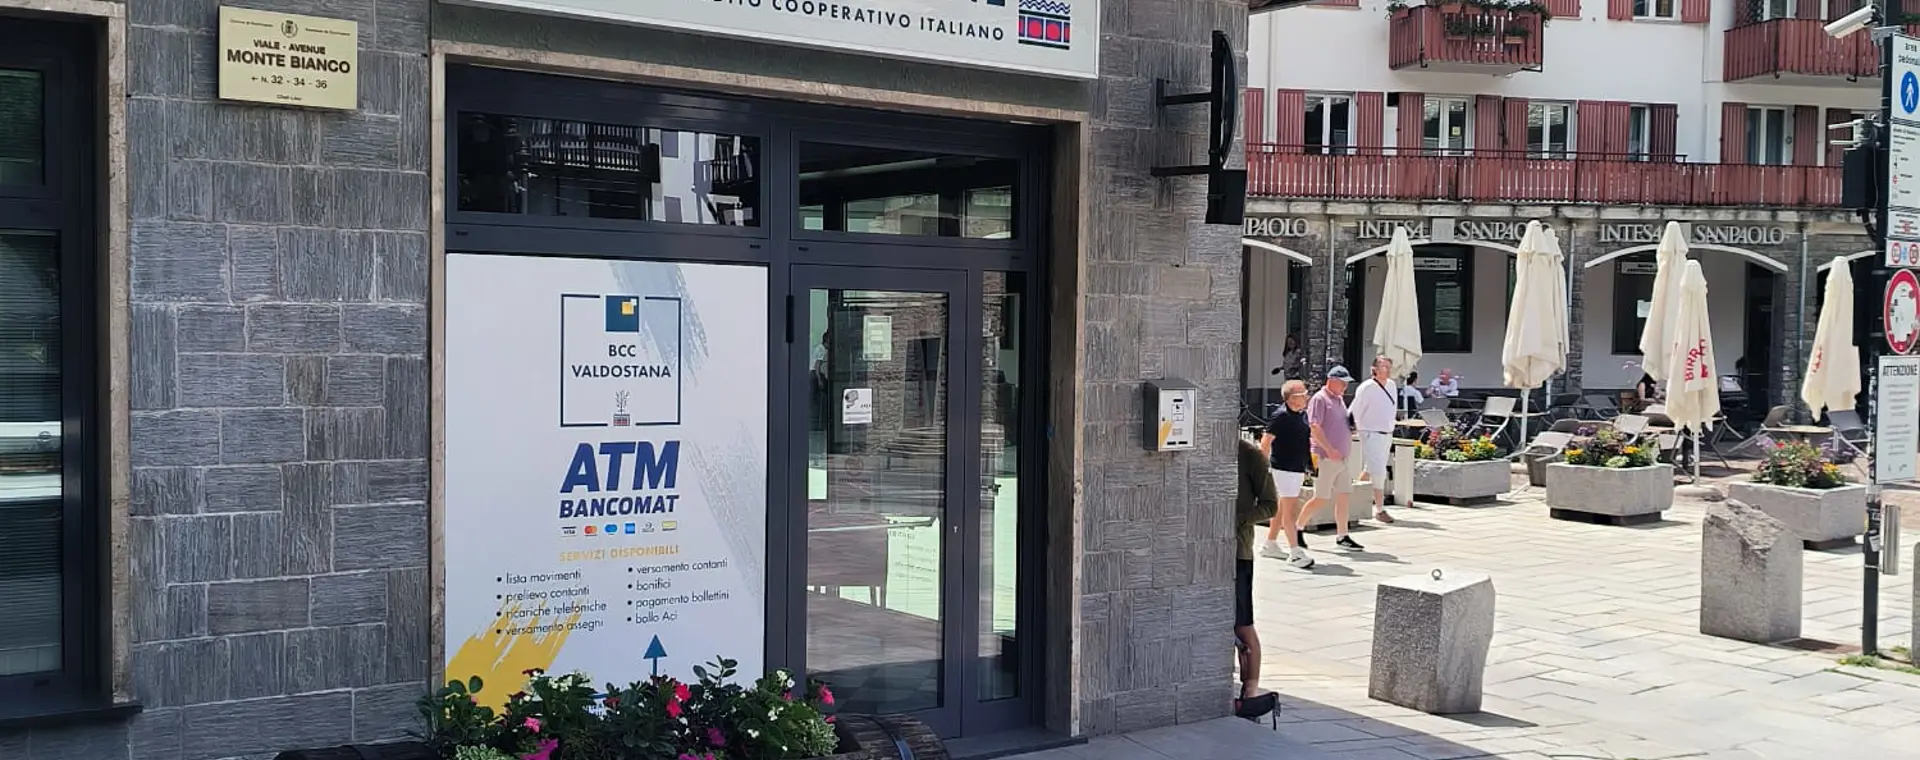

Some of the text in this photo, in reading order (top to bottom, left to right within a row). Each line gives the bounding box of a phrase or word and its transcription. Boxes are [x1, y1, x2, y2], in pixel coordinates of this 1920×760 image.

[772, 0, 1004, 41] COOPERATIVO ITALIANO
[253, 39, 280, 50] VIALE
[289, 43, 326, 55] AVENUE
[227, 49, 351, 74] MONTE BIANCO
[271, 75, 284, 85] 32
[293, 77, 305, 87] 34
[315, 79, 328, 89] 36
[1599, 223, 1785, 245] INTESA SANPAOLO
[608, 344, 636, 357] BCC
[571, 365, 672, 378] VALDOSTANA
[1883, 364, 1918, 377] ATTENZIONE
[559, 440, 681, 494] ATM
[559, 495, 680, 518] BANCOMAT
[559, 544, 679, 562] SERVIZI DISPONIBILI
[636, 557, 728, 574] versamento contanti
[506, 569, 581, 584] lista movimenti
[636, 577, 671, 591] bonifici
[506, 585, 590, 604] prelievo contanti
[635, 589, 730, 610] pagamento bollettini
[506, 600, 607, 619] ricariche telefoniche
[635, 610, 678, 624] bollo Aci
[506, 618, 604, 636] versamento assegni
